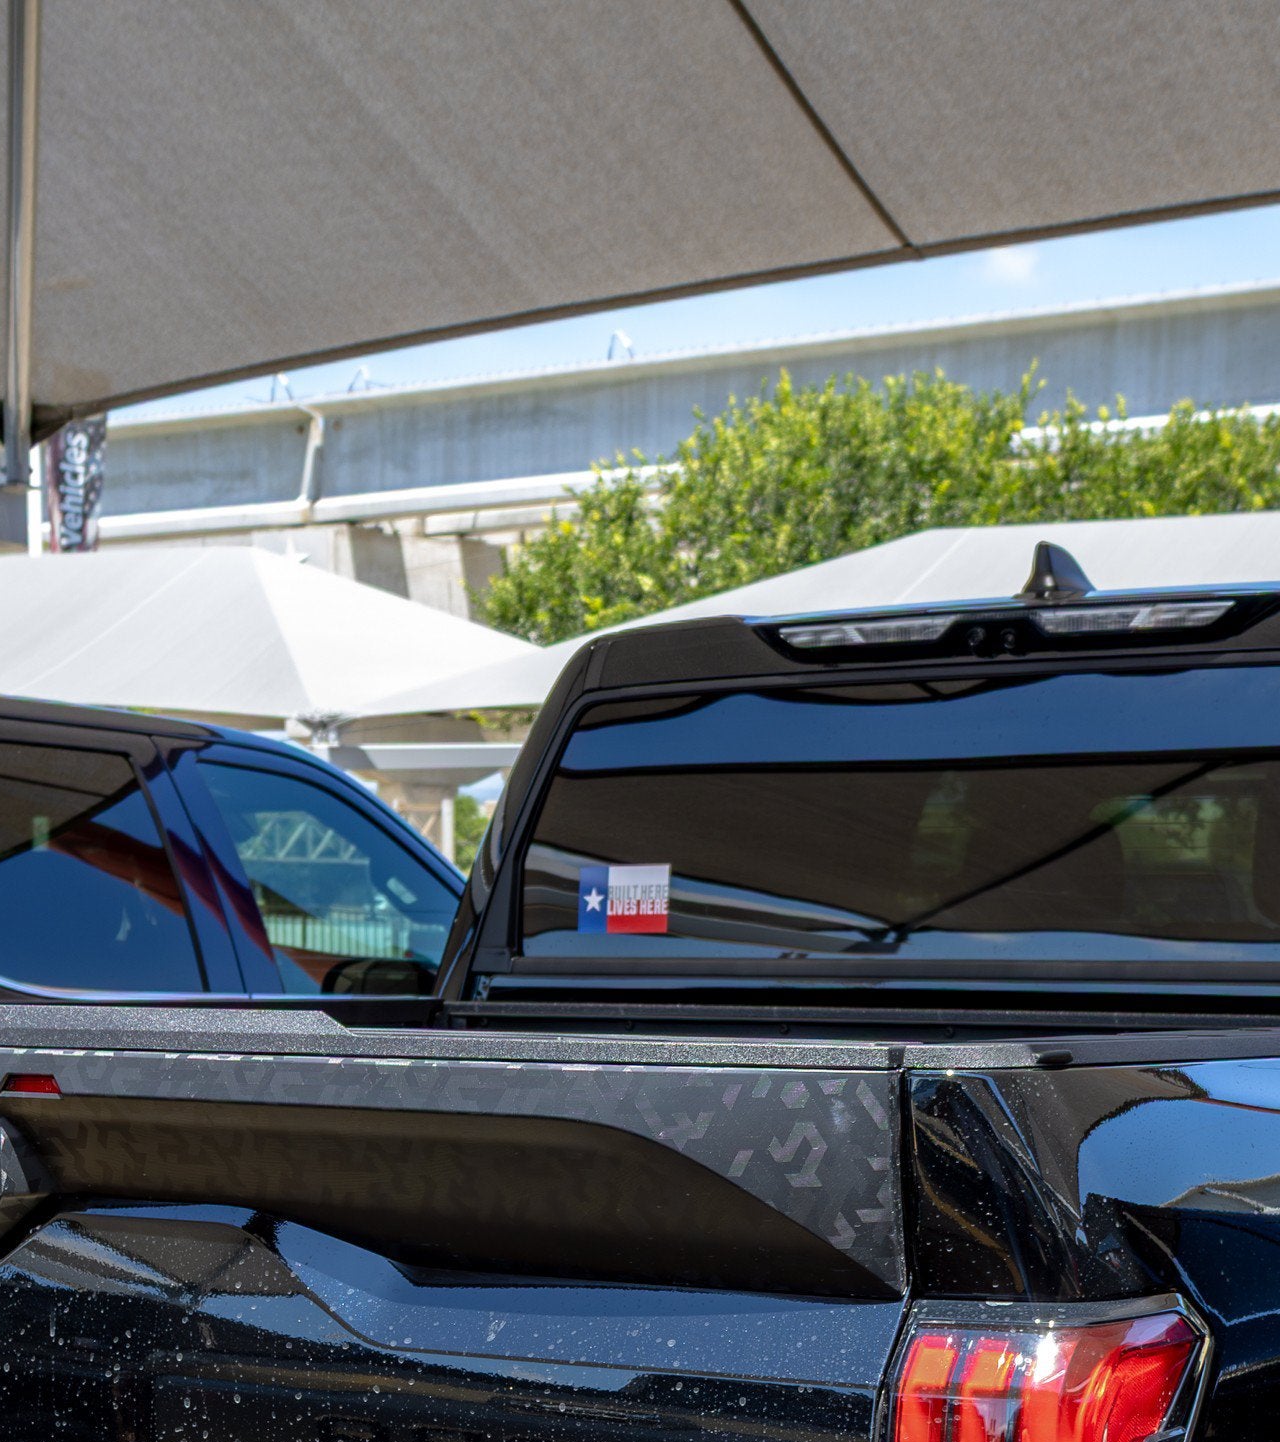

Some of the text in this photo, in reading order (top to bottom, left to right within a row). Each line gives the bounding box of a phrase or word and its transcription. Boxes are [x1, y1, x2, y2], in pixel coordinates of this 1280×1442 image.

[608, 884, 669, 900] BUILT HERE
[606, 899, 668, 916] LIVES HERE
